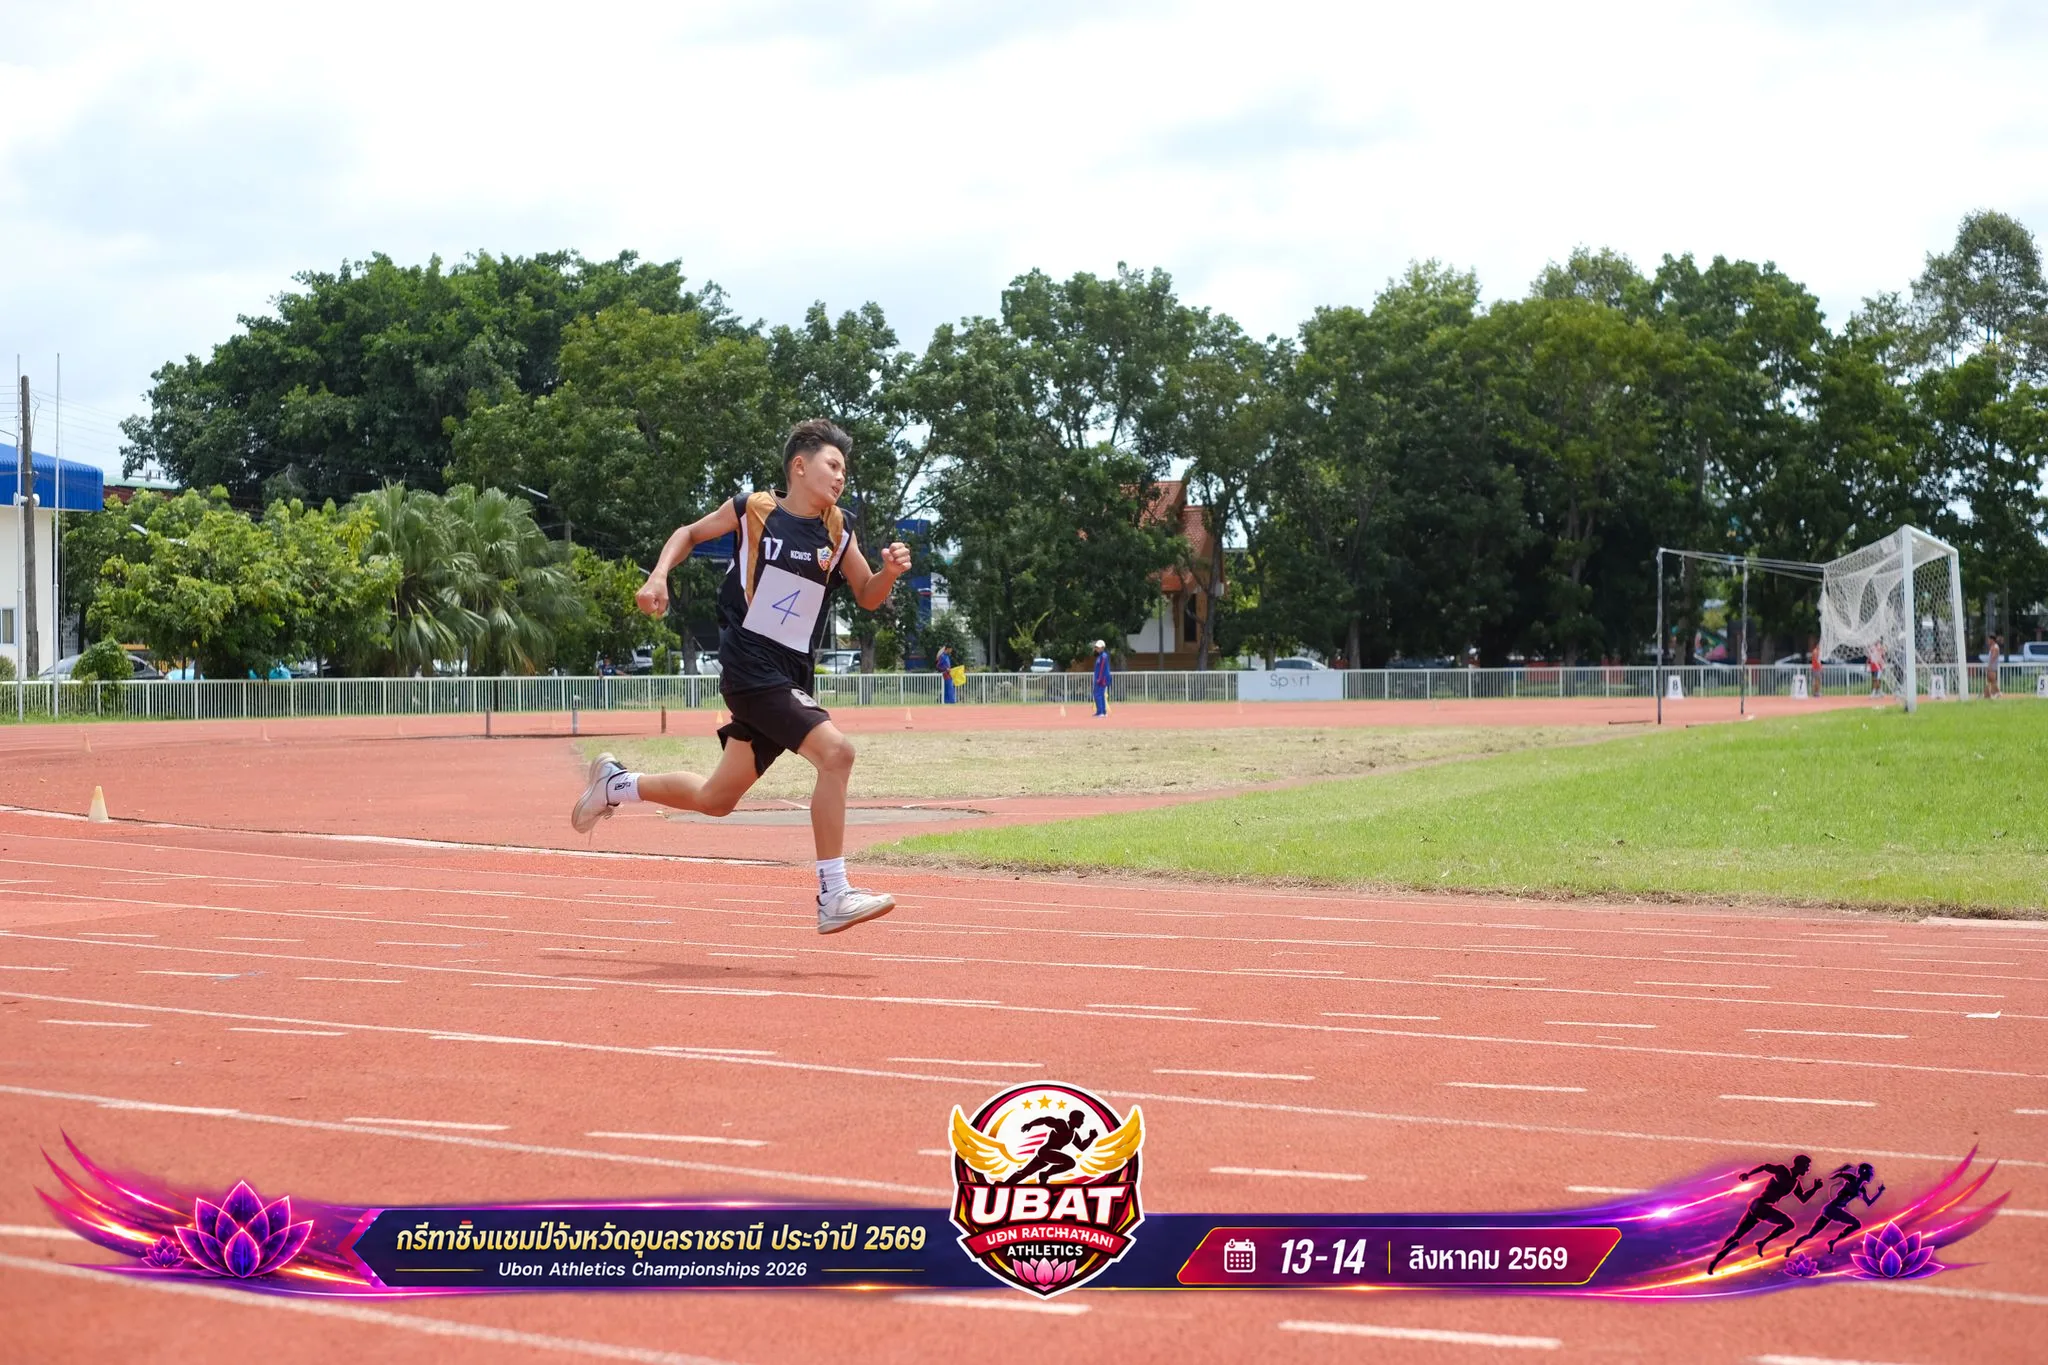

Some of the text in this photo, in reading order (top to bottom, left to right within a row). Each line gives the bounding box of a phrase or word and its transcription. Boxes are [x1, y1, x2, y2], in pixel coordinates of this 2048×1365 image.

[762, 537, 783, 561] 17
[772, 589, 801, 625] 4
[1672, 680, 1679, 691] 8
[1797, 679, 1804, 691] 7
[2039, 679, 2045, 690] 5
